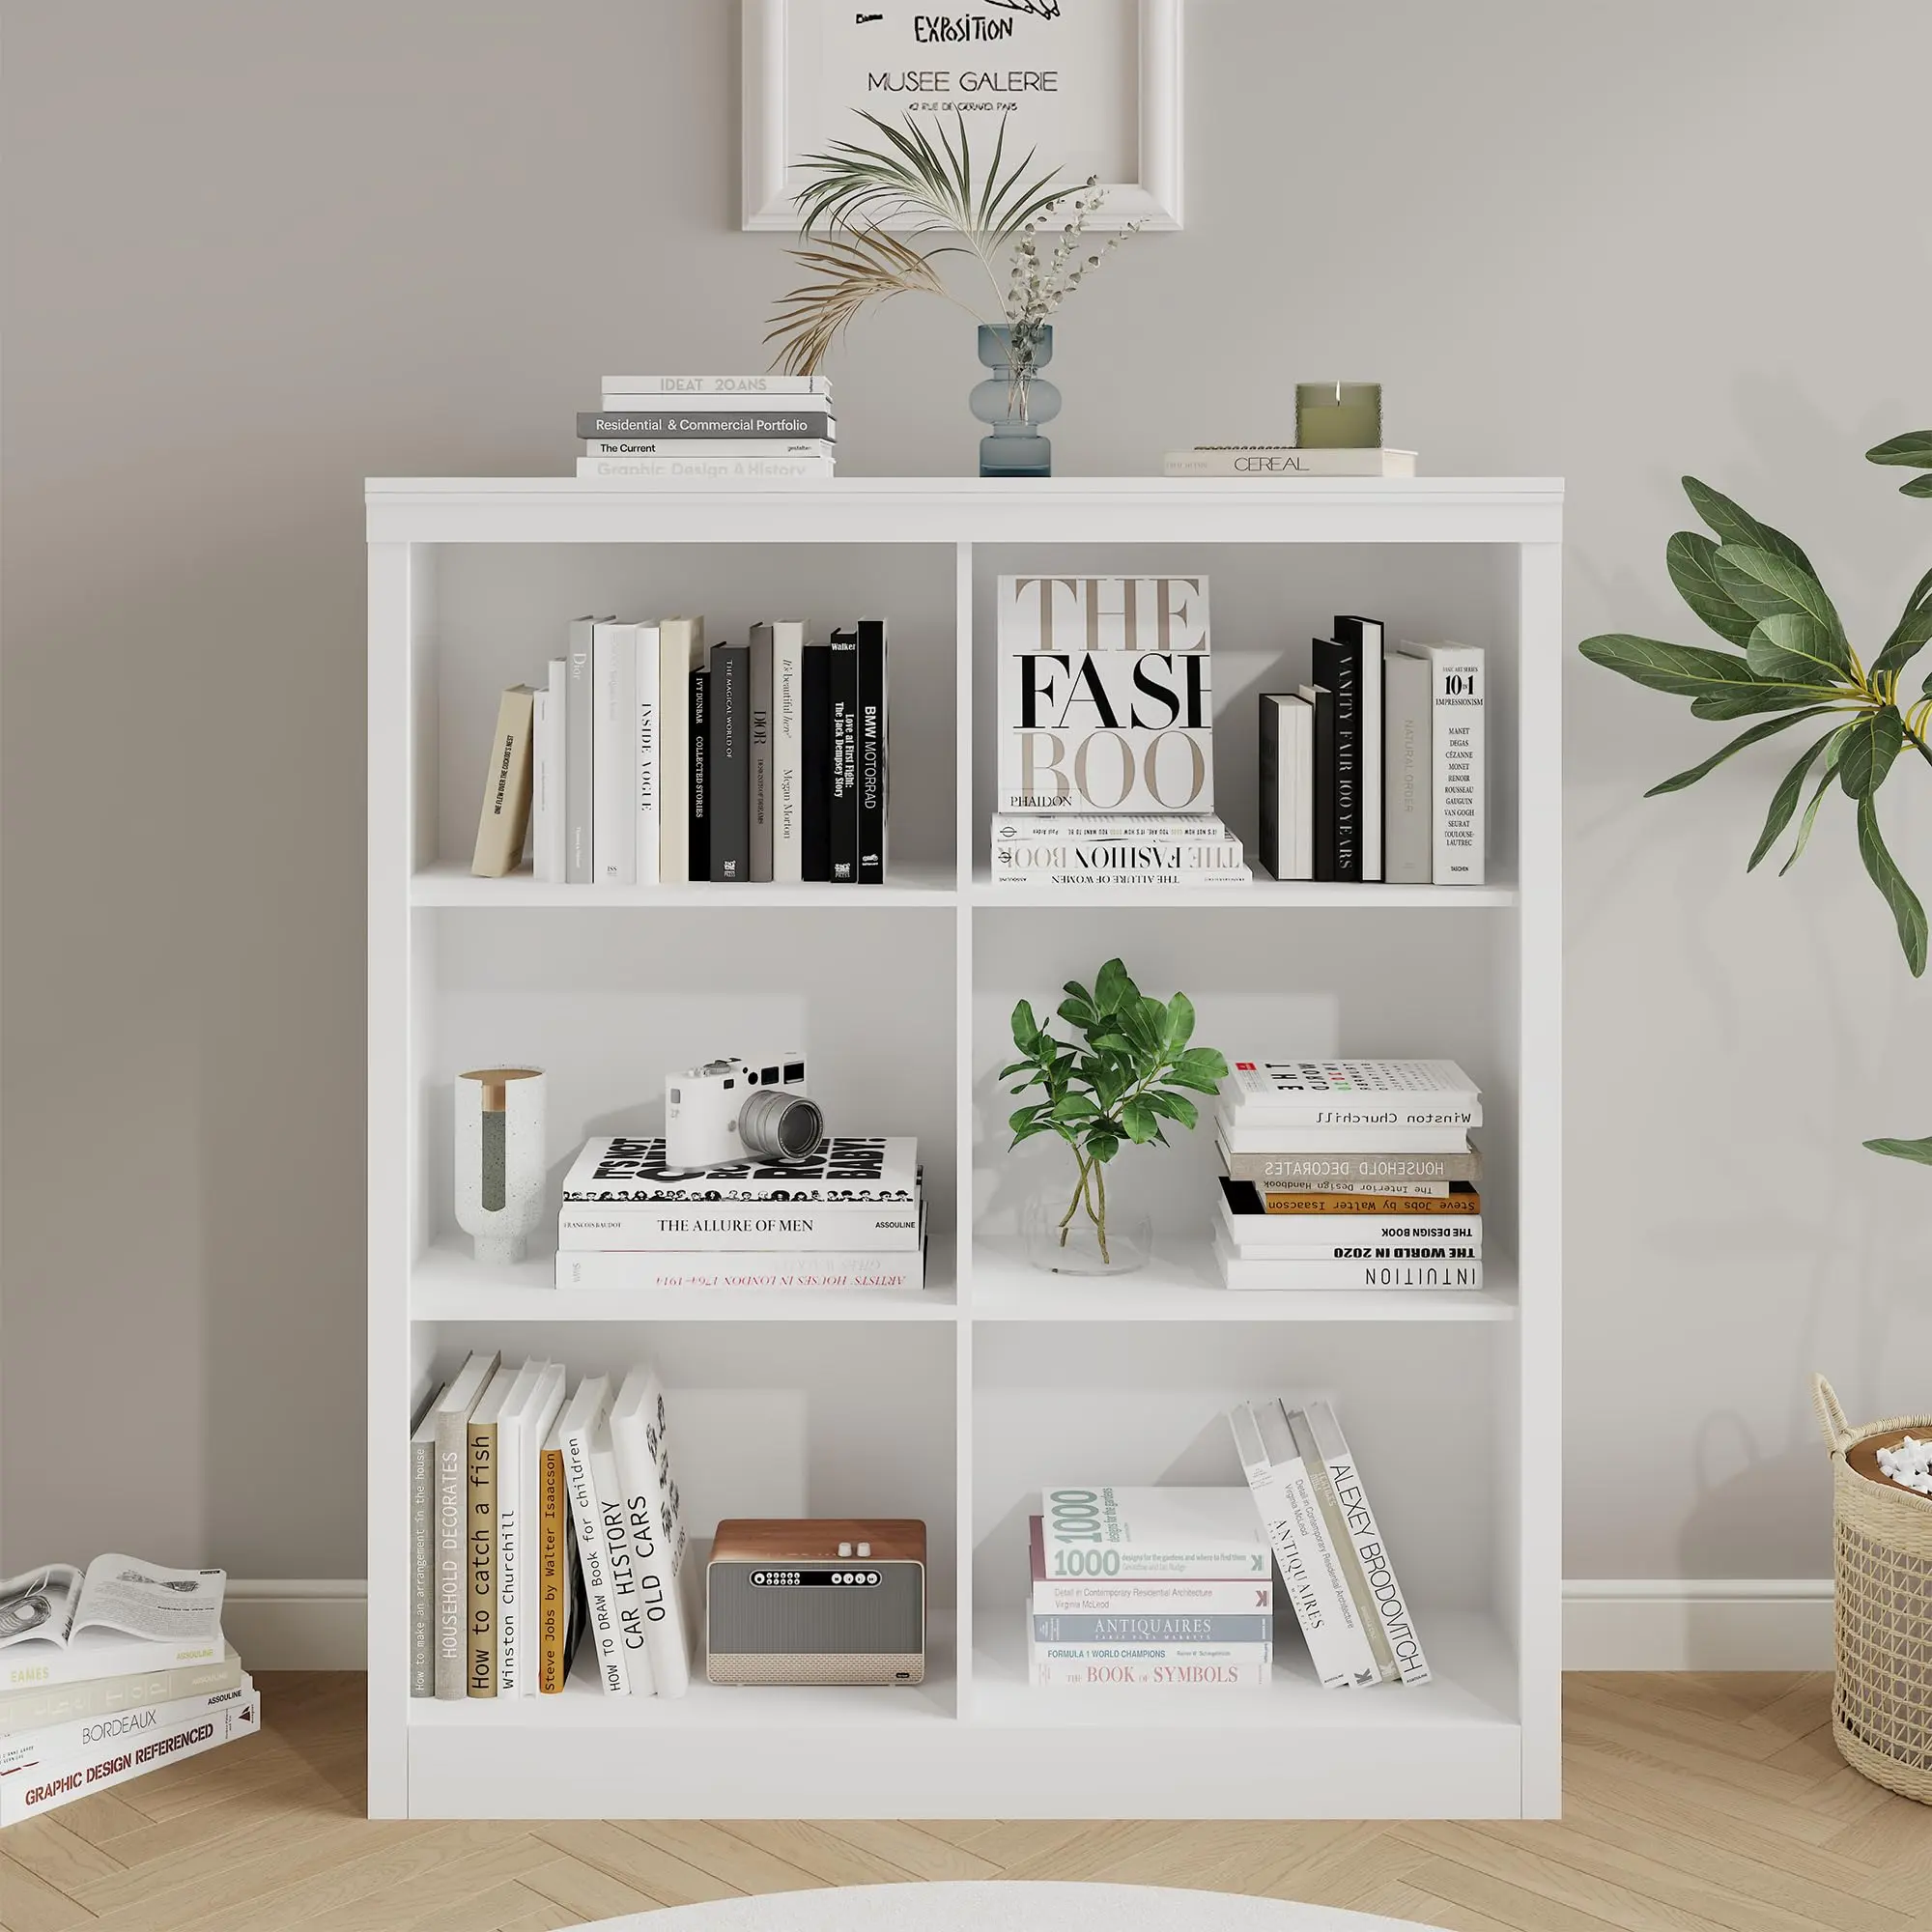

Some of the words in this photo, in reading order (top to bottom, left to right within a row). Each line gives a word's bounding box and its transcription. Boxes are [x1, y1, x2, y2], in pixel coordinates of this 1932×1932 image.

[914, 14, 1013, 43] EXPOSITION
[867, 71, 951, 92] MUSEE
[958, 71, 1059, 92] GALERIE
[660, 378, 703, 391] IDEAT
[596, 419, 662, 431] Residential
[667, 419, 678, 431] &
[679, 419, 753, 431] Commercial
[755, 419, 809, 432] Portfolio
[600, 443, 618, 453] The
[619, 443, 656, 453] Current
[1234, 457, 1310, 471] CEREAL
[1014, 578, 1207, 652] THE
[831, 642, 856, 651] Walker
[572, 652, 587, 680] Dior
[782, 673, 793, 714] beautiful
[1339, 656, 1352, 723] VANITY
[835, 701, 844, 718] The
[641, 703, 652, 754] INSIDE
[753, 711, 767, 745] DIOR
[834, 719, 844, 737] Jack
[844, 713, 855, 733] Love
[865, 706, 876, 738] BMW
[505, 734, 514, 748] NEST
[1339, 730, 1352, 772] FAIR
[1405, 719, 1414, 769] NATURAL
[834, 739, 844, 776] Dempsey
[844, 744, 855, 763] First
[1445, 750, 1473, 759] CÉZANNE
[641, 760, 652, 811] VOGUE
[781, 769, 793, 801] Megan
[844, 764, 855, 788] Fight:
[864, 741, 877, 810] MOTORRAD
[834, 777, 844, 799] Story
[1405, 775, 1414, 813] ORDER
[1010, 796, 1072, 808] PHAIDON
[782, 804, 793, 839] Morton
[1339, 812, 1352, 869] YEARS
[1075, 846, 1181, 869] FASHION
[1188, 846, 1240, 869] THE
[1051, 874, 1096, 885] WOMEN
[1096, 874, 1110, 885] OF
[1113, 874, 1155, 885] ALLURE
[1156, 874, 1180, 885] THE
[603, 1138, 652, 1159] NOT
[825, 1138, 888, 1179] BABY!
[1263, 1180, 1312, 1189] Handbook
[1317, 1181, 1354, 1192] Design
[1359, 1183, 1408, 1194] Interior
[1413, 1185, 1433, 1194] The
[1268, 1200, 1326, 1210] Isaacson
[1332, 1200, 1377, 1210] Walter
[1382, 1199, 1397, 1210] by
[1404, 1200, 1432, 1210] Jobs
[1439, 1201, 1475, 1210] Steve
[657, 1219, 690, 1233] THE
[692, 1219, 753, 1233] ALLURE
[755, 1219, 777, 1233] OF
[779, 1219, 814, 1233] MEN
[1381, 1228, 1410, 1237] BOOK
[1412, 1228, 1451, 1237] DESIGN
[1452, 1228, 1473, 1237] THE
[1333, 1247, 1372, 1259] 2020
[1375, 1247, 1391, 1259] IN
[1393, 1247, 1447, 1259] WORLD
[1448, 1247, 1476, 1259] THE
[723, 1274, 778, 1286] LONDON
[796, 1274, 848, 1286] HOUSES
[1365, 1267, 1477, 1286] INTUITION
[415, 1448, 425, 1481] house
[471, 1435, 490, 1488] fish
[569, 1437, 590, 1508] children
[415, 1486, 425, 1505] the
[544, 1452, 555, 1519] Isaacson
[441, 1451, 458, 1549] DECORATES
[475, 1502, 490, 1515] a
[627, 1495, 654, 1558] CARS
[1049, 1490, 1103, 1545] 1000
[1293, 1509, 1309, 1537] McLeod
[582, 1518, 594, 1543] for
[1305, 1506, 1327, 1553] Contemporary
[502, 1510, 515, 1605] Churchill
[544, 1527, 555, 1577] Walter
[601, 1500, 636, 1596] HISTORY
[415, 1529, 427, 1596] arrangement
[471, 1529, 490, 1596] catch
[587, 1551, 604, 1586] Book
[1054, 1548, 1121, 1577] 1000
[1329, 1464, 1376, 1537] ALEXEY
[1359, 1542, 1423, 1673] BRODOVITCH
[1273, 1520, 1325, 1630] ANTIQUAIRES
[544, 1584, 557, 1601] by
[641, 1575, 666, 1621] OLD
[1083, 1587, 1131, 1599] Contemporary
[1133, 1587, 1171, 1597] Residential
[1172, 1587, 1213, 1597] Architecture
[415, 1604, 425, 1617] an
[441, 1559, 458, 1659] HOUSEHOLD
[596, 1594, 611, 1631] DRAW
[1082, 1600, 1110, 1608] McLeod
[471, 1609, 490, 1634] to
[544, 1608, 555, 1642] Jobs
[621, 1607, 644, 1649] CAR
[1094, 1618, 1212, 1634] ANTIQUAIRES
[415, 1622, 425, 1648] make
[502, 1614, 515, 1690] Winston
[603, 1639, 614, 1657] TO
[1047, 1649, 1085, 1659] FORMULA
[1092, 1649, 1120, 1659] WORLD
[1121, 1649, 1167, 1659] CHAMPIONS
[415, 1653, 425, 1666] to
[471, 1649, 490, 1690] How
[544, 1650, 555, 1691] Steve
[11, 1666, 49, 1683] EAMES
[415, 1671, 425, 1691] How
[606, 1663, 621, 1691] HOW
[1087, 1665, 1136, 1683] BOOK
[1153, 1665, 1239, 1683] SYMBOLS
[207, 1690, 242, 1705] ASSOULINE
[82, 1709, 156, 1745] BORDEAUX
[25, 1772, 83, 1806] GRAPHIC
[86, 1752, 132, 1783] DESIGN
[135, 1722, 214, 1766] REFERENCED
